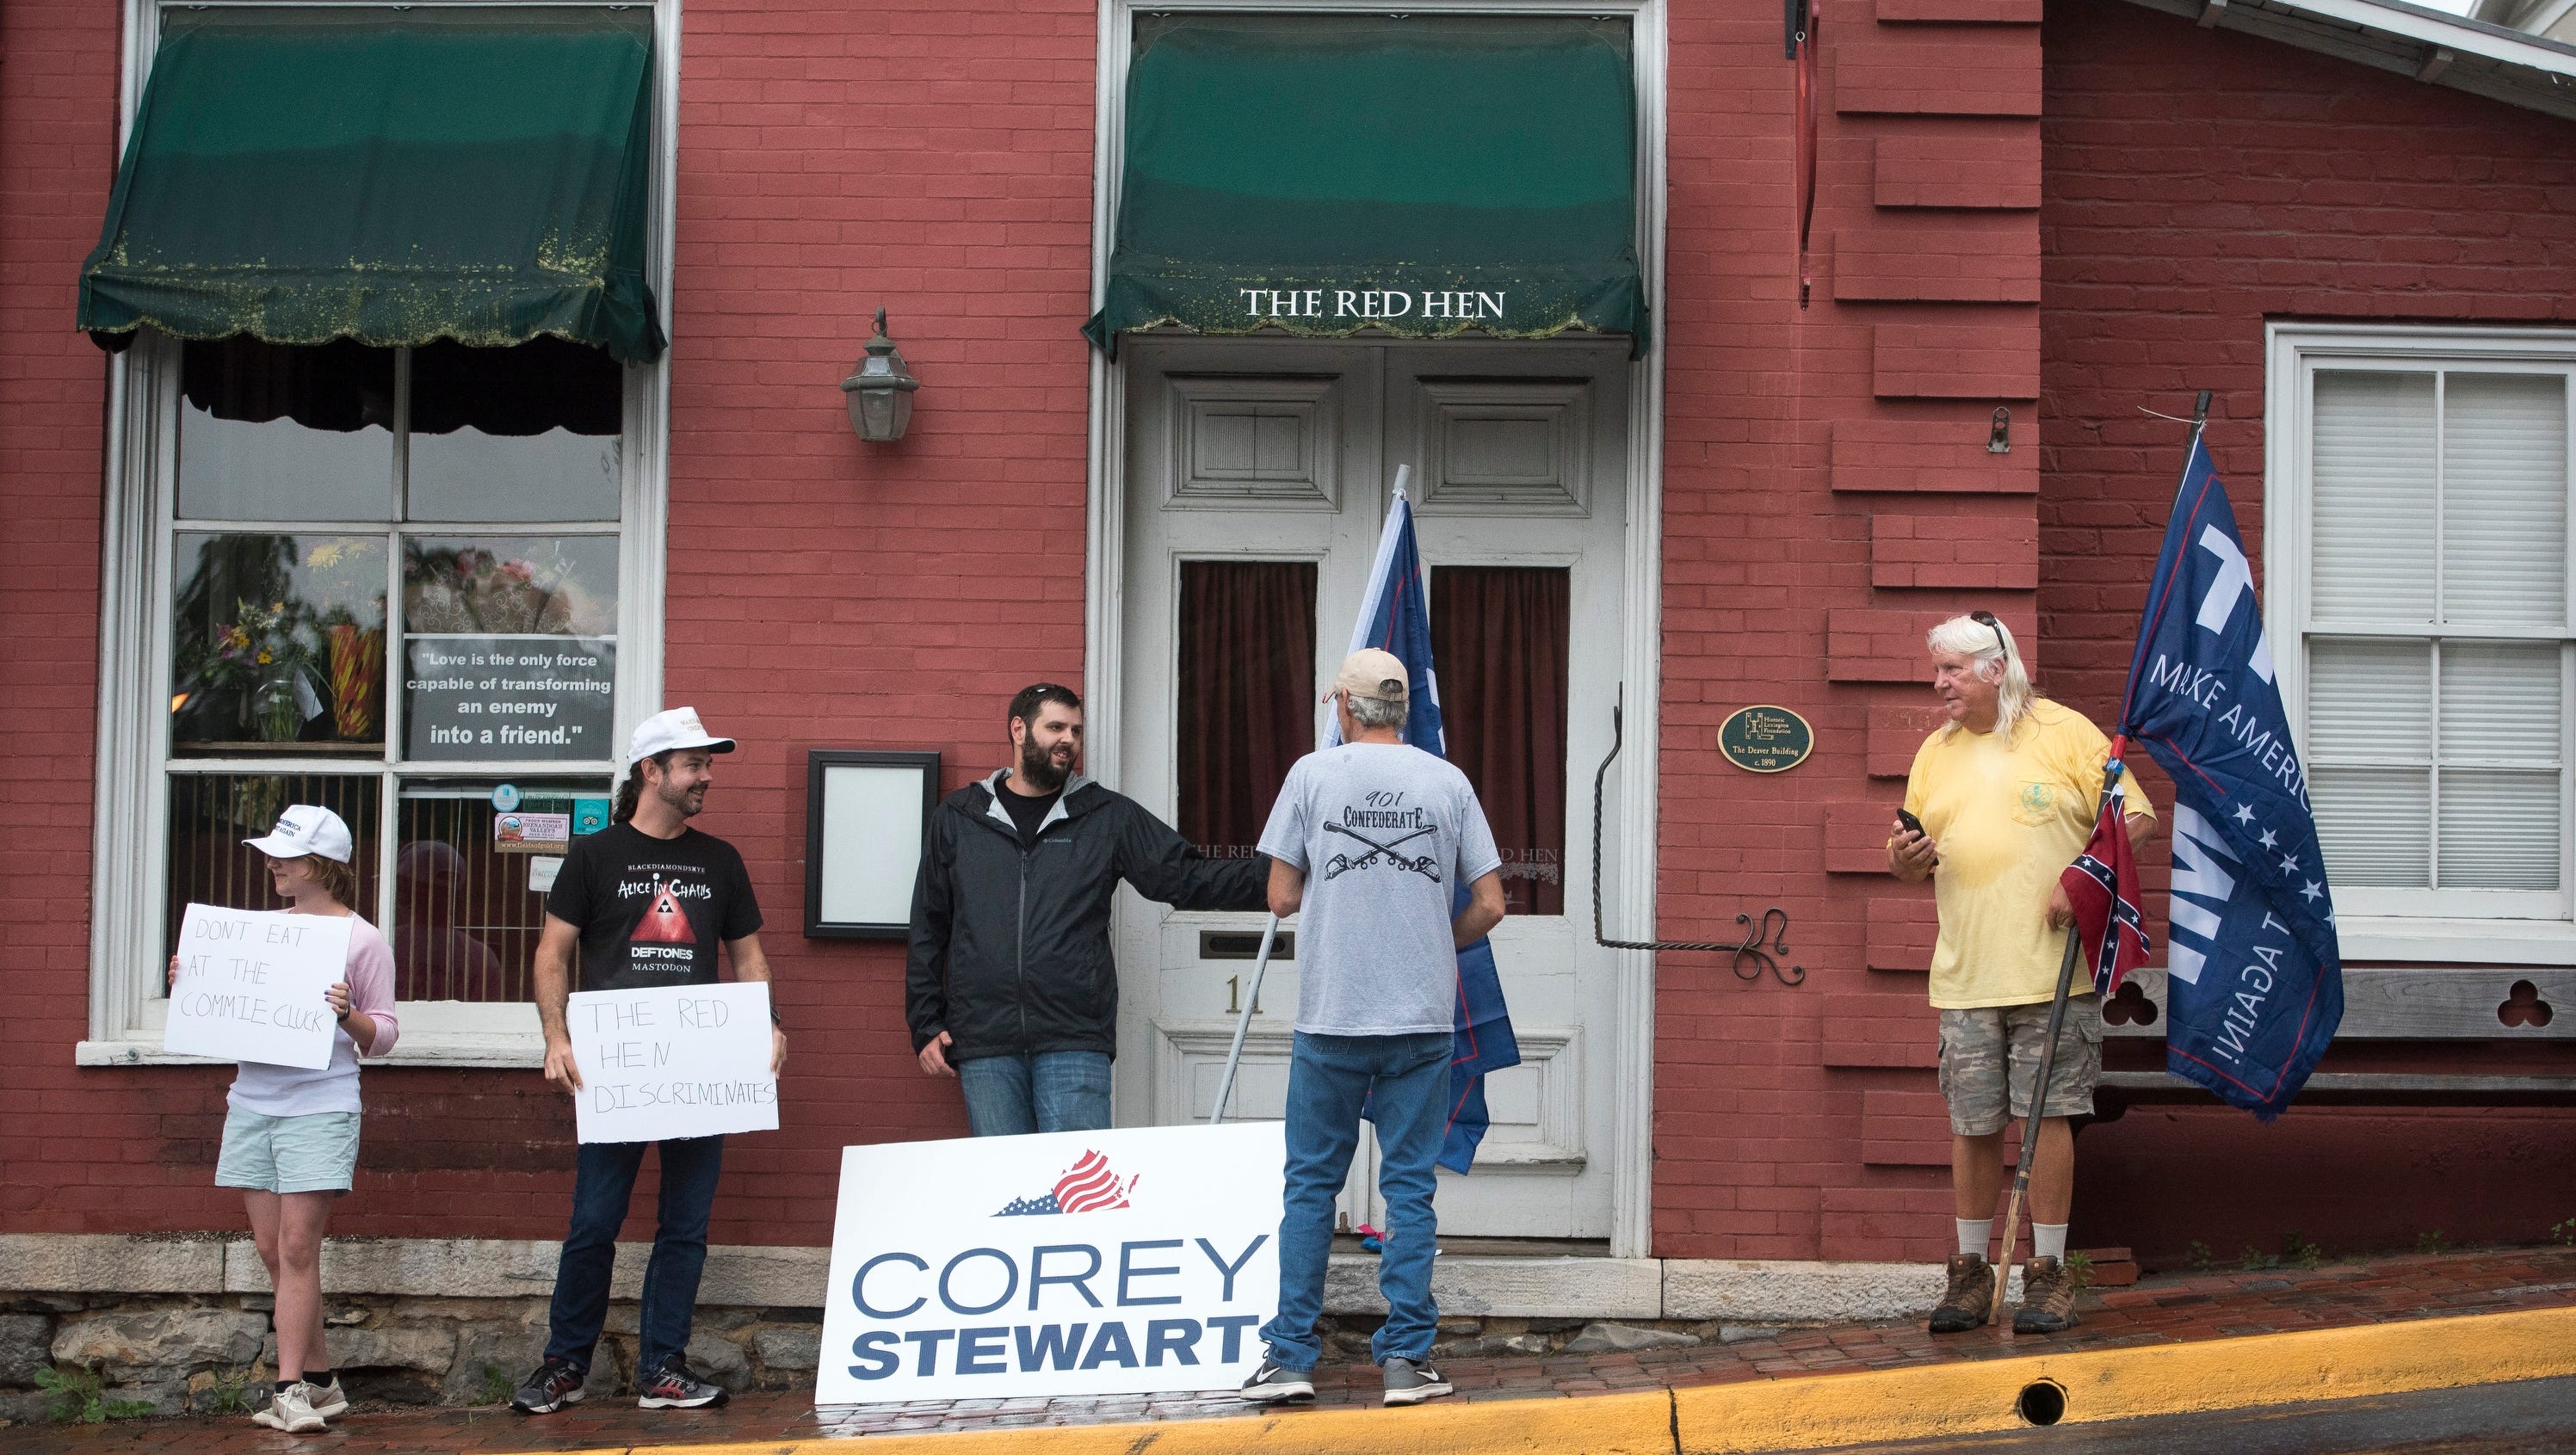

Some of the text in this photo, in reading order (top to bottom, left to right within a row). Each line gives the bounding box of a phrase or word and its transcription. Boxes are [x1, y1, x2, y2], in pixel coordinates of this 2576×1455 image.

[1240, 288, 1505, 320] THE RED HEN
[422, 653, 597, 669] "Love is the only force
[406, 678, 611, 694] capable of transforming
[457, 702, 557, 718] an enemy
[430, 725, 583, 744] into a friend."
[2149, 654, 2227, 710] MAKE
[2217, 704, 2313, 818] AMERIC
[1771, 747, 1799, 756] Building
[1365, 791, 1404, 807] 901
[1344, 805, 1423, 829] CONFEDERATE
[1193, 844, 1222, 859] HE
[1520, 848, 1559, 861] HEN
[618, 880, 651, 899] ALICE
[670, 879, 712, 900] CHAINS
[267, 924, 310, 946] EAT
[631, 946, 694, 960] DEFTONES
[188, 955, 271, 984] AT THE
[632, 963, 691, 972] MASTODON
[181, 992, 324, 1033] COMMIE CLUCK
[580, 998, 728, 1033] THE RED
[595, 1080, 776, 1113] DISCRIMINATES
[851, 1234, 1269, 1321] COREY
[848, 1315, 1260, 1381] STEWART
